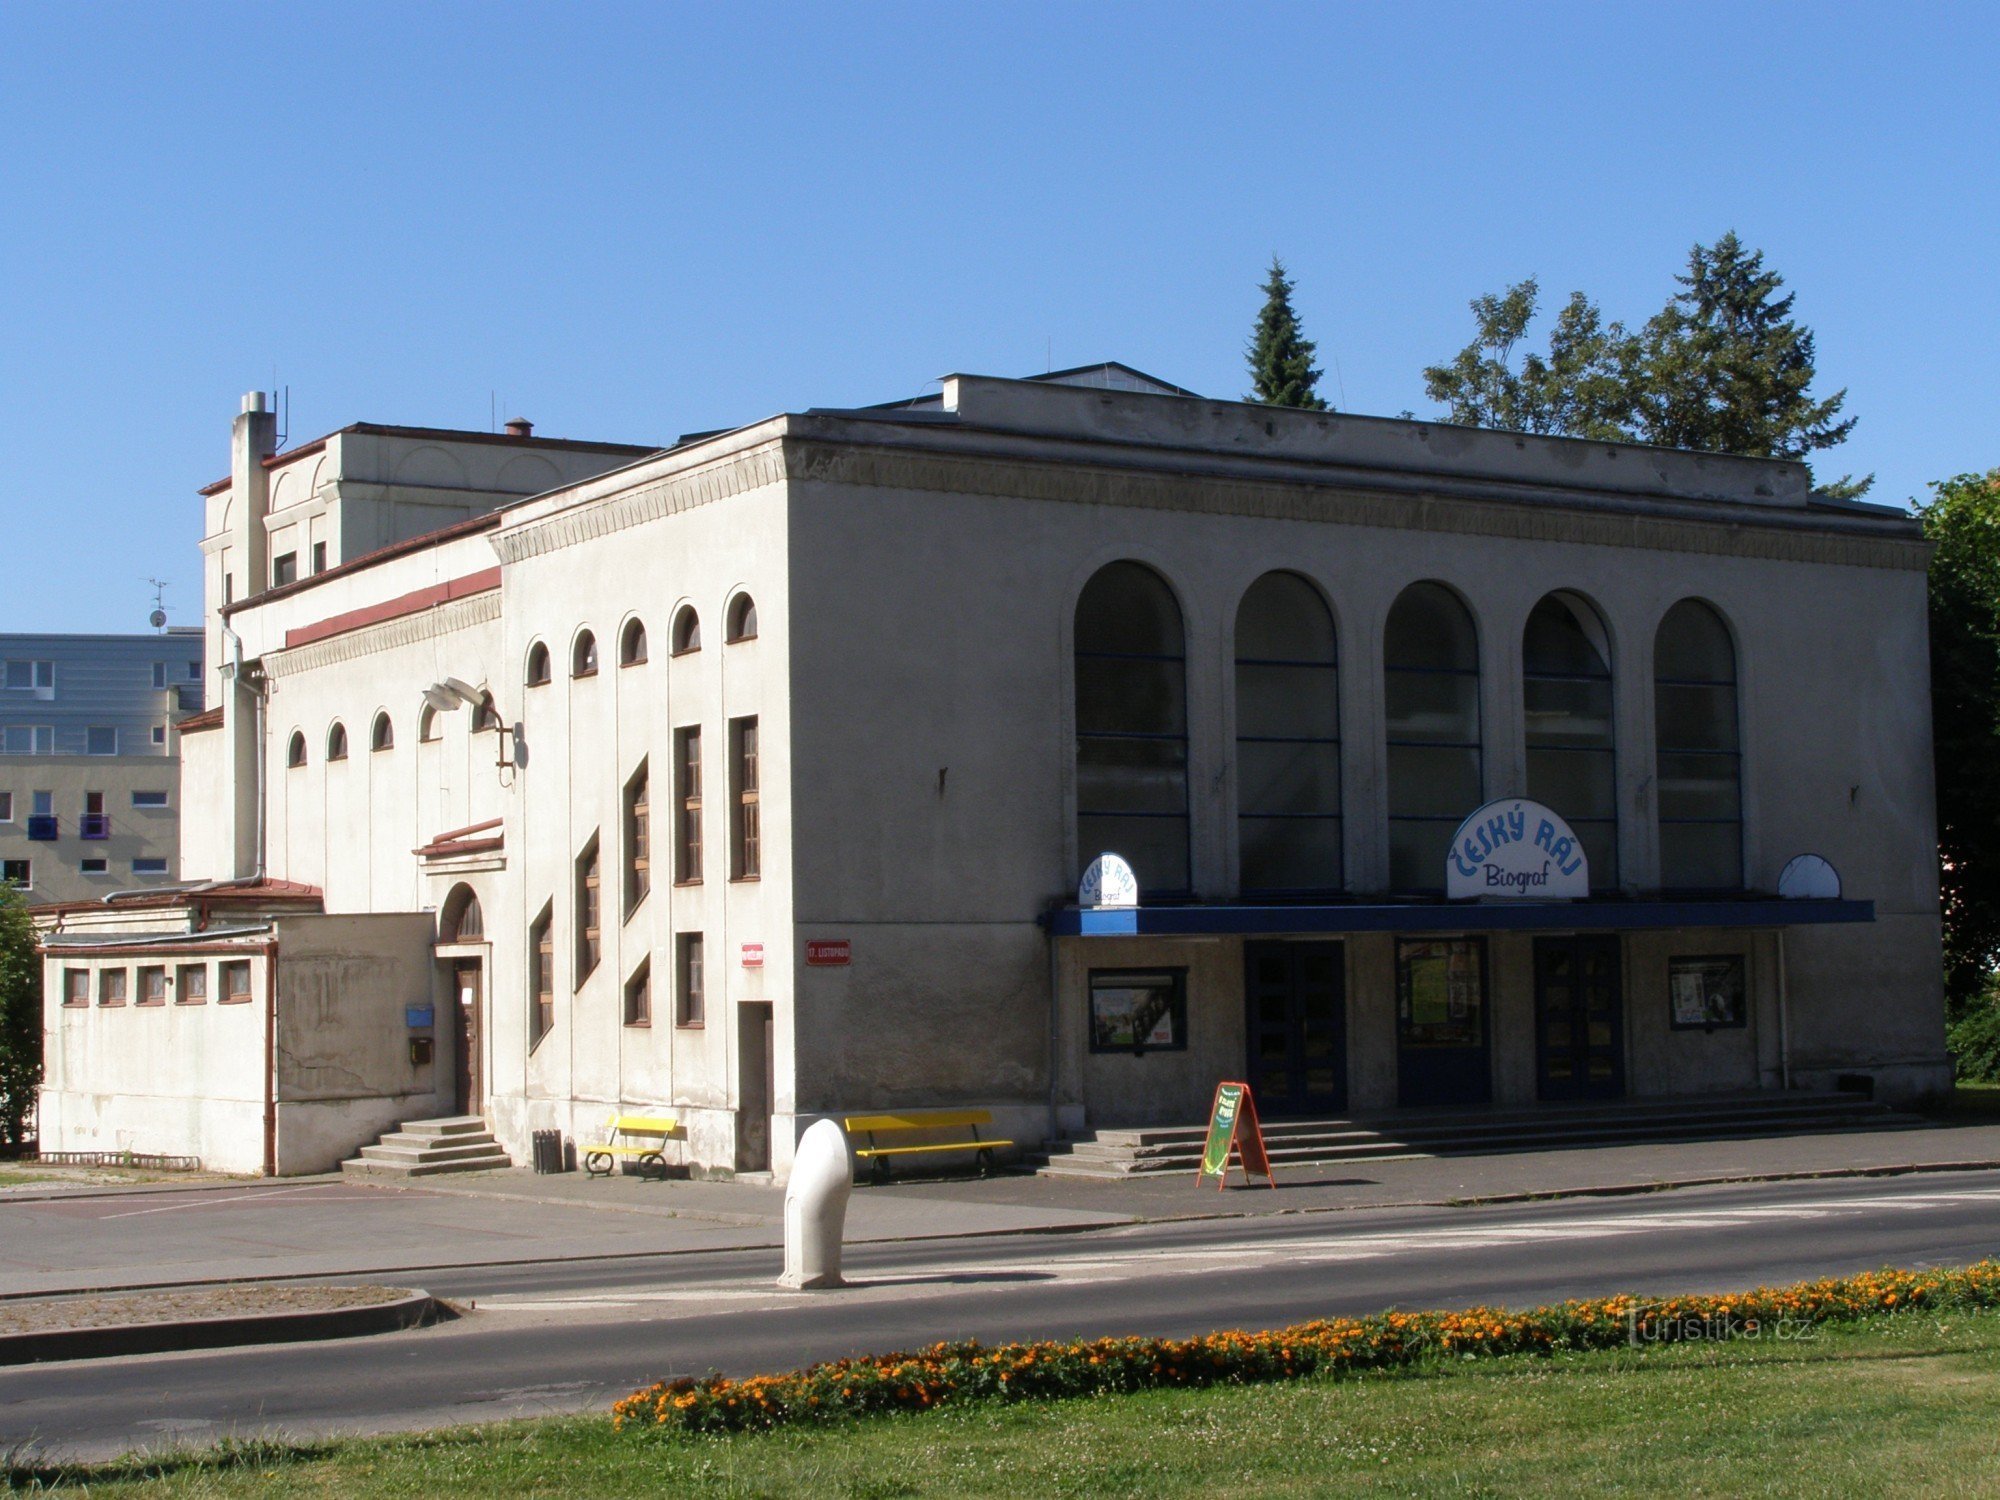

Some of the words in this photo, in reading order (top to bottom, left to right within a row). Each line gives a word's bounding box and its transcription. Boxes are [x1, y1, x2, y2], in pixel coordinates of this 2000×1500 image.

[1449, 803, 1524, 877] ČESKÝ
[1534, 818, 1582, 876] RÁJ
[1483, 860, 1551, 894] Biograf
